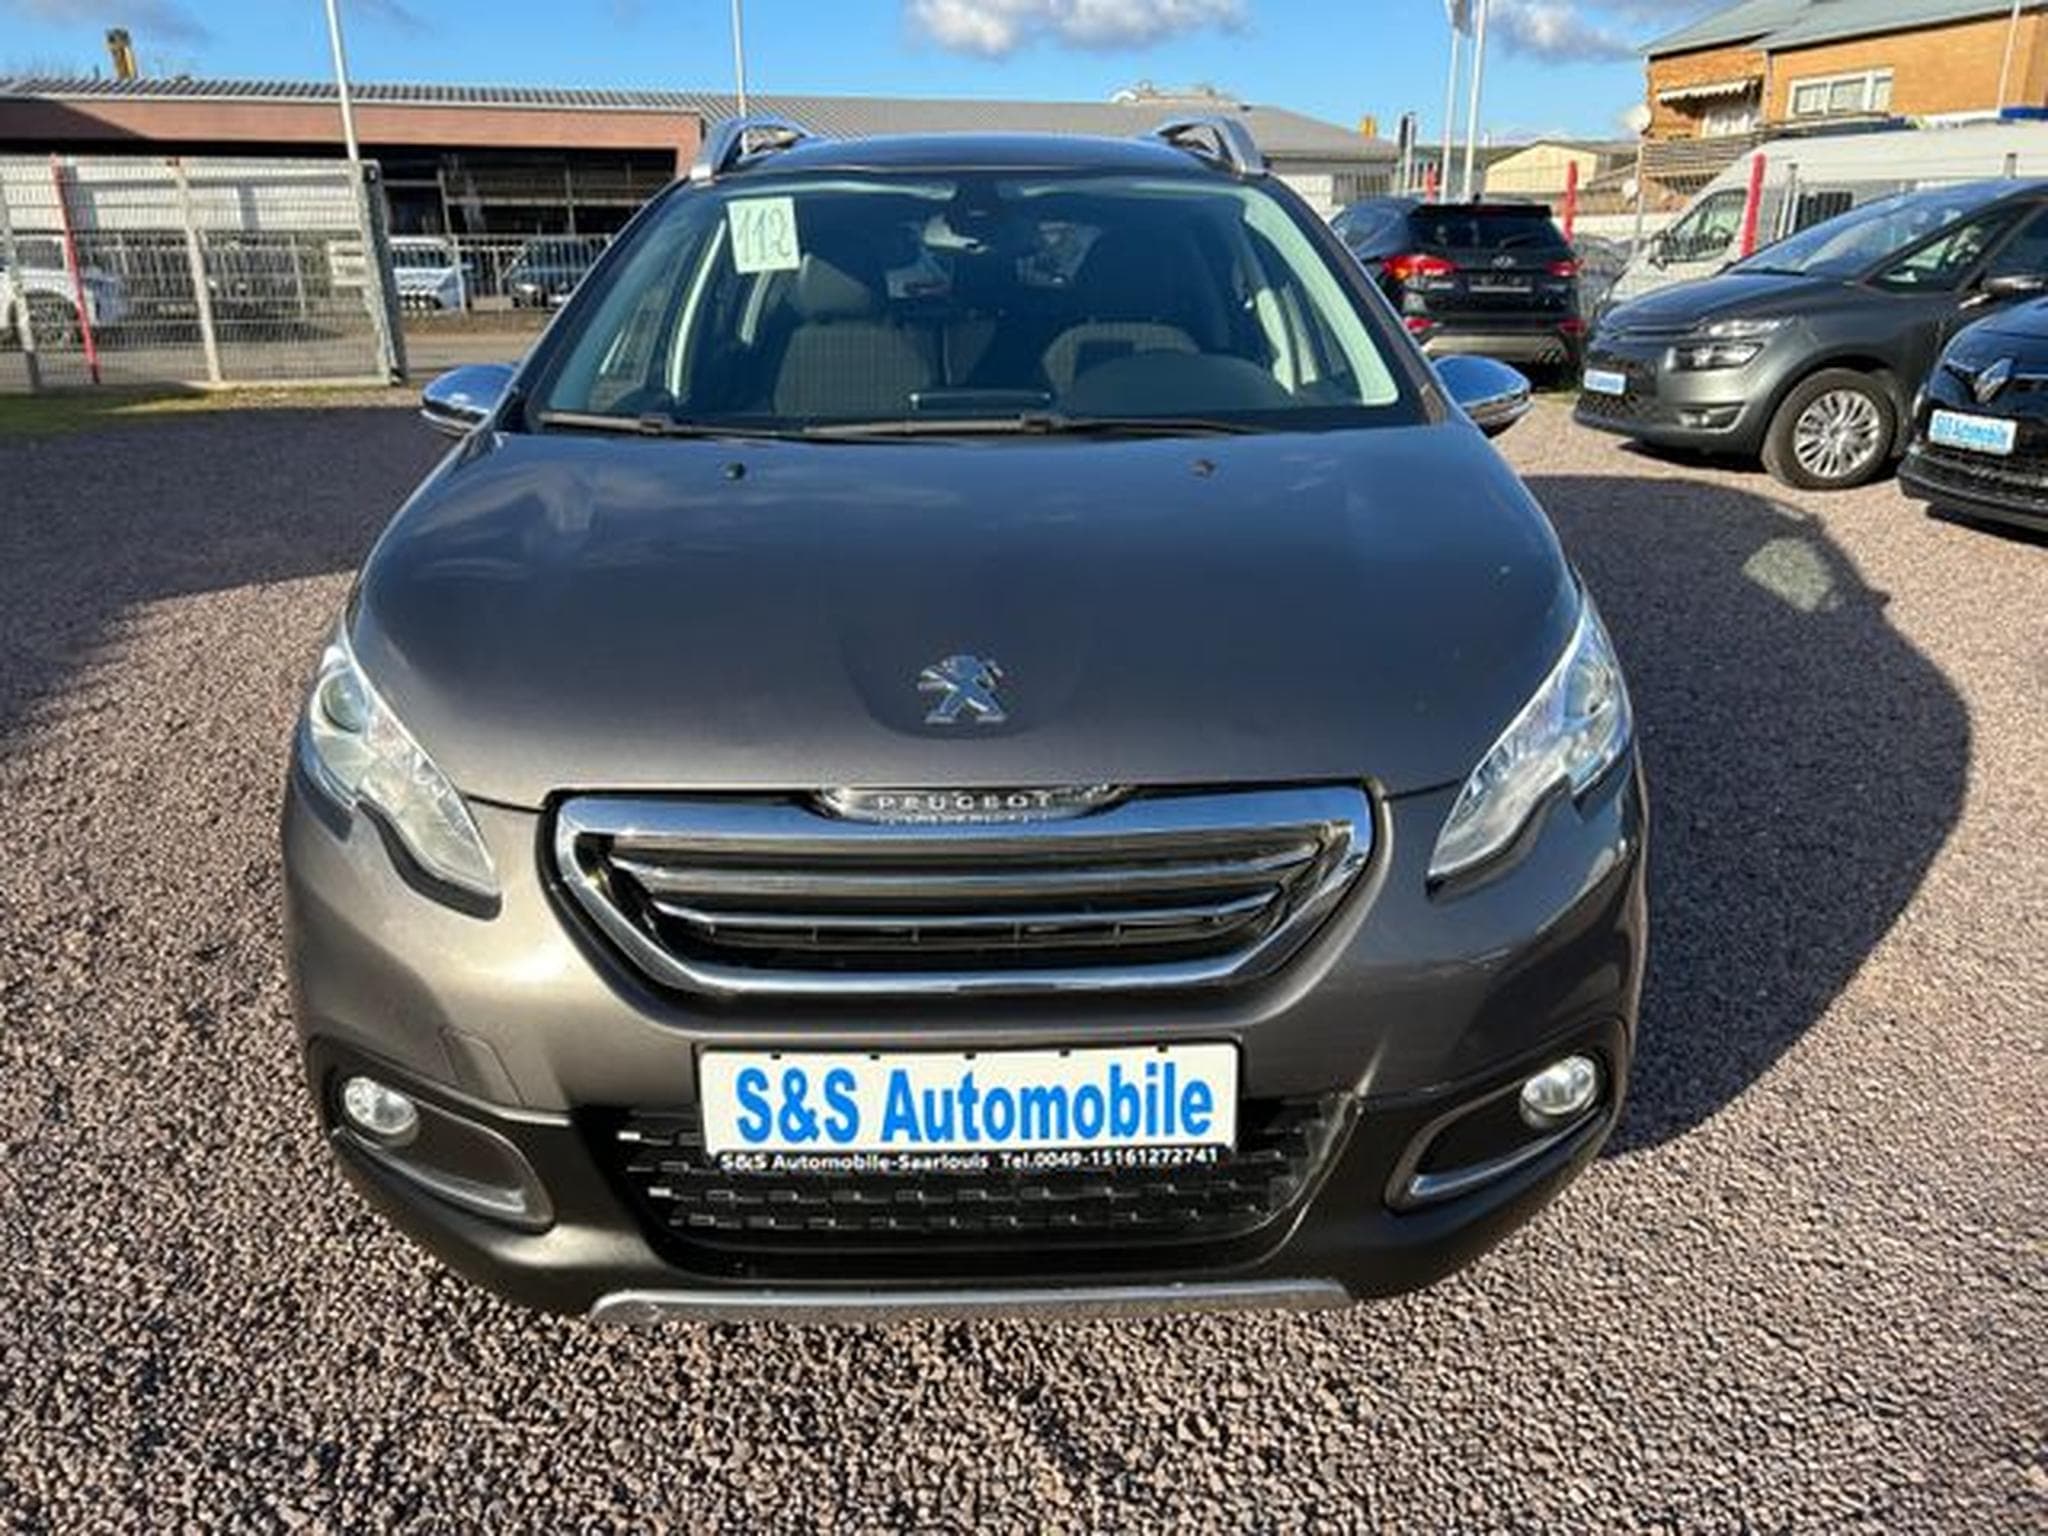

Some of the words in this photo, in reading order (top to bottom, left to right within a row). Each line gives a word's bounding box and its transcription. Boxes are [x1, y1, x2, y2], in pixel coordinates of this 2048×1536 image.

[878, 793, 1051, 811] PEUGEOT
[736, 1068, 861, 1143] S&S
[881, 1062, 1213, 1142] Automobile
[721, 1154, 767, 1170] S&S
[772, 1152, 990, 1170] Automobile-Saarlouis
